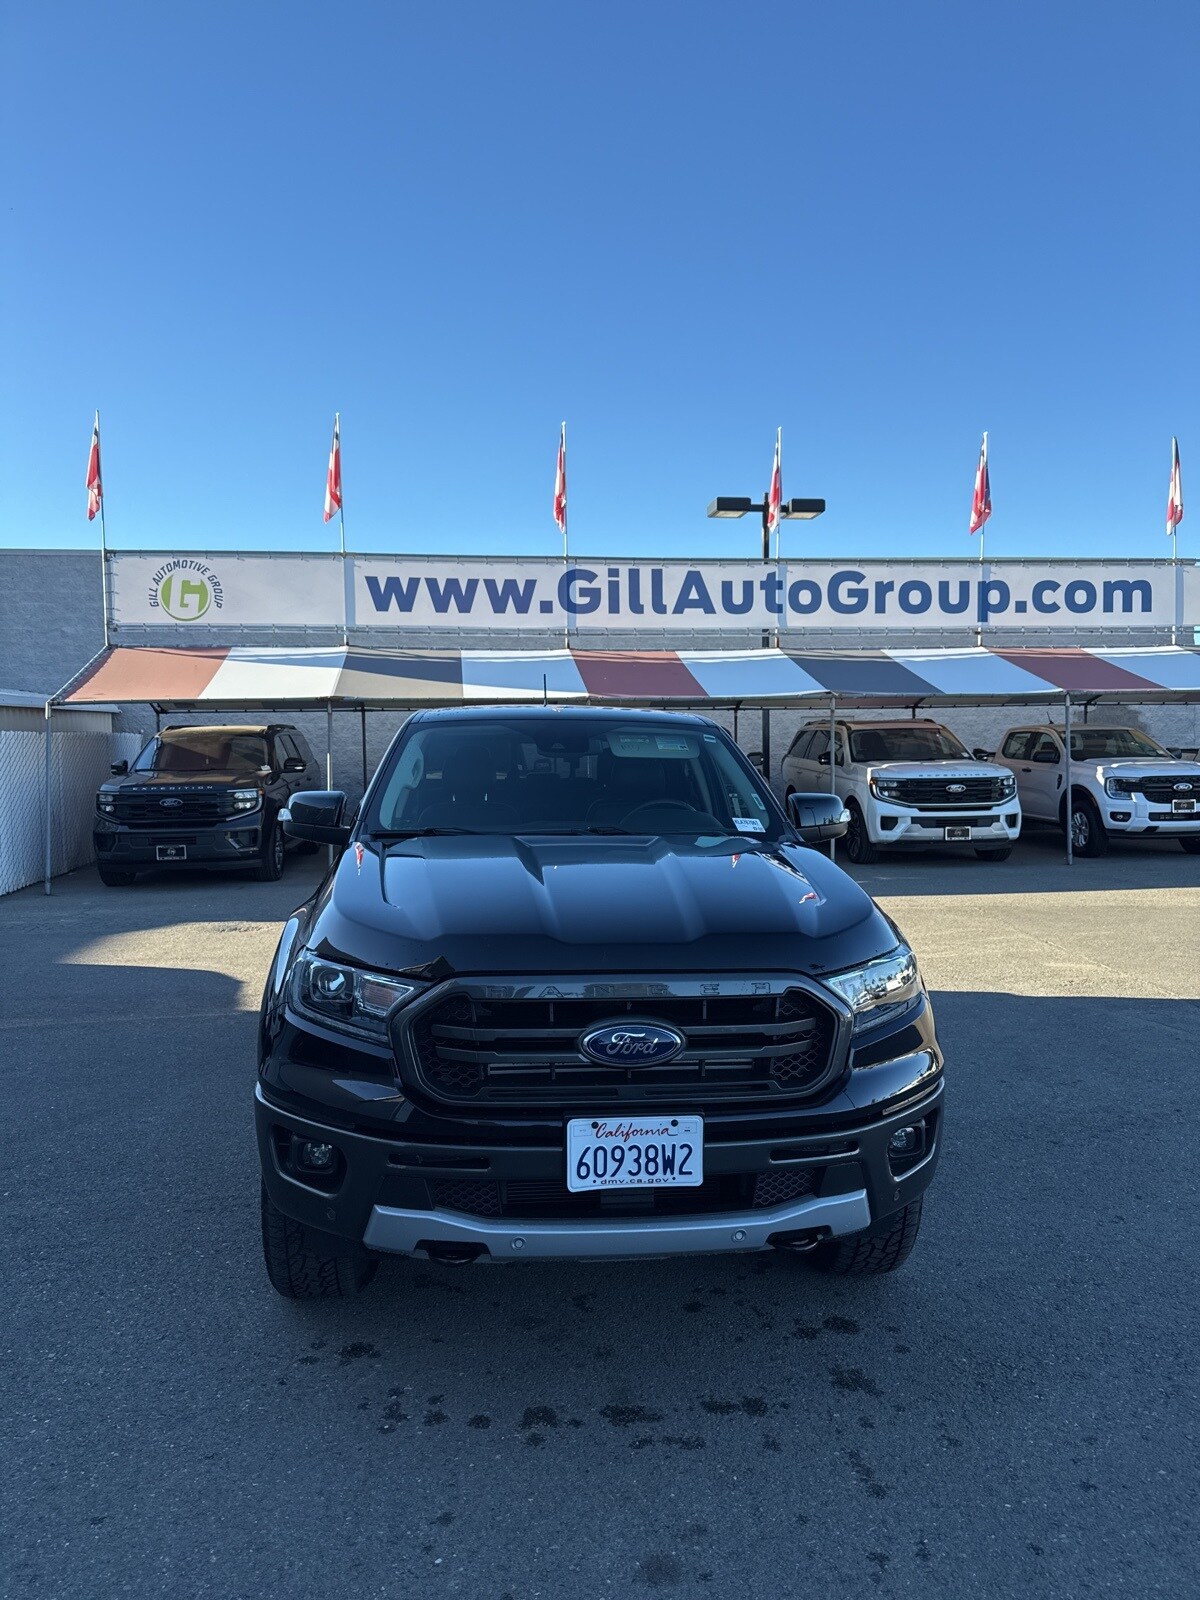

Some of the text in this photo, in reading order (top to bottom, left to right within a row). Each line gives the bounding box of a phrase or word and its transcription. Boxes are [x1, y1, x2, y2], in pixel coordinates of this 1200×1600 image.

[148, 559, 224, 609] GILL AUTOMOTIVE GROUP
[364, 567, 1153, 623] www.GillAutoGroup.com
[485, 982, 771, 998] RANGER
[605, 1031, 658, 1055] Ford
[595, 1122, 678, 1142] California
[576, 1143, 693, 1180] 60938W2
[600, 1177, 669, 1185] dmv.ca.gov
